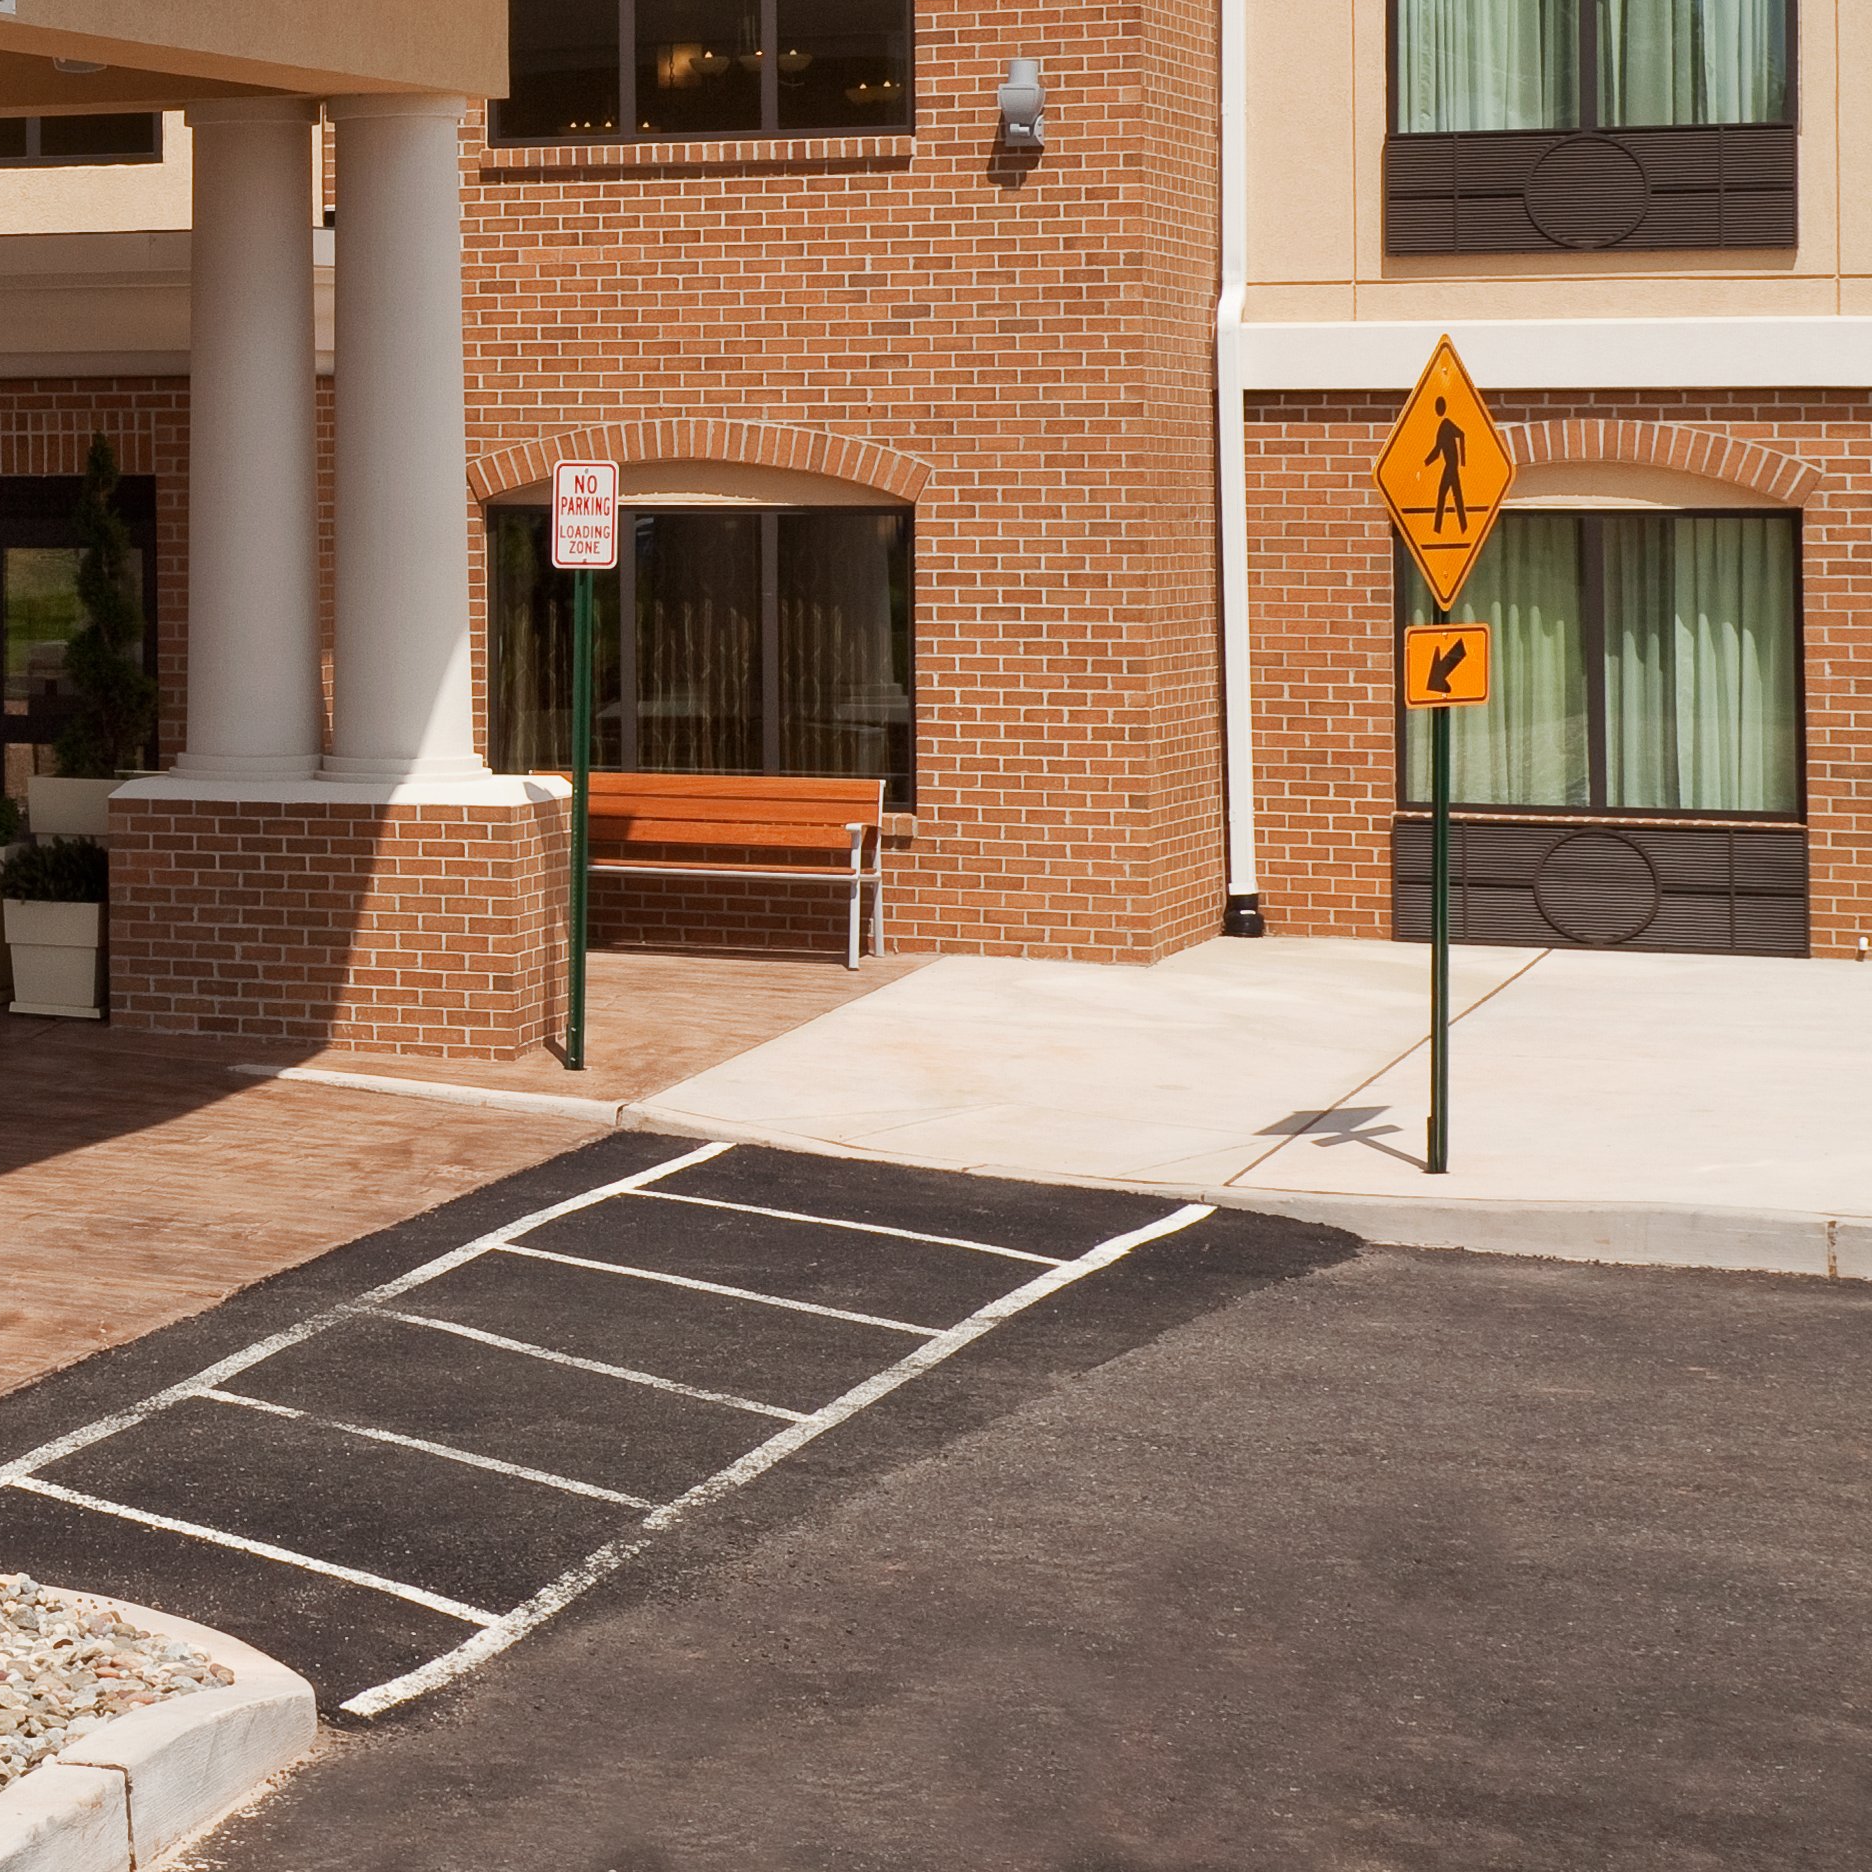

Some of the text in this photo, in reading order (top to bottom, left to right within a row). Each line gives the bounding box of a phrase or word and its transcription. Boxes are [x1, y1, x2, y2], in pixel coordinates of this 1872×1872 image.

[574, 475, 598, 494] NO
[560, 496, 610, 516] PARKING
[559, 525, 610, 539] LOADING
[569, 541, 600, 554] ZONE
